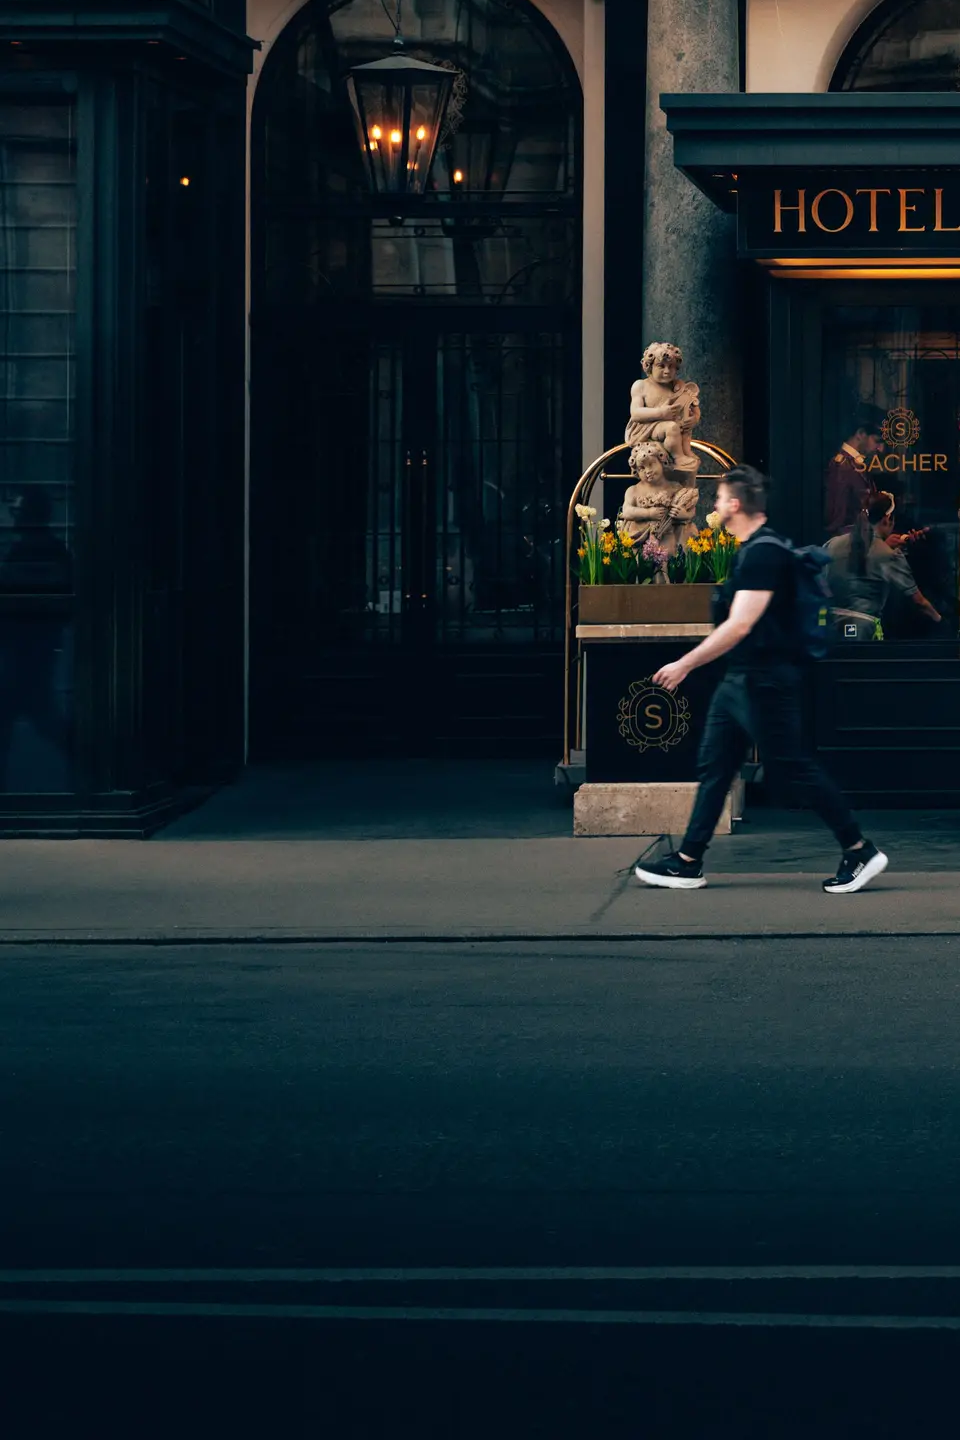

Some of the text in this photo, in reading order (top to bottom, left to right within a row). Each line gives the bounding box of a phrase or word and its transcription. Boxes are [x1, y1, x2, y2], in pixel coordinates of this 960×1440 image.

[895, 422, 906, 437] S
[855, 453, 948, 473] SACHER
[644, 704, 663, 729] S
